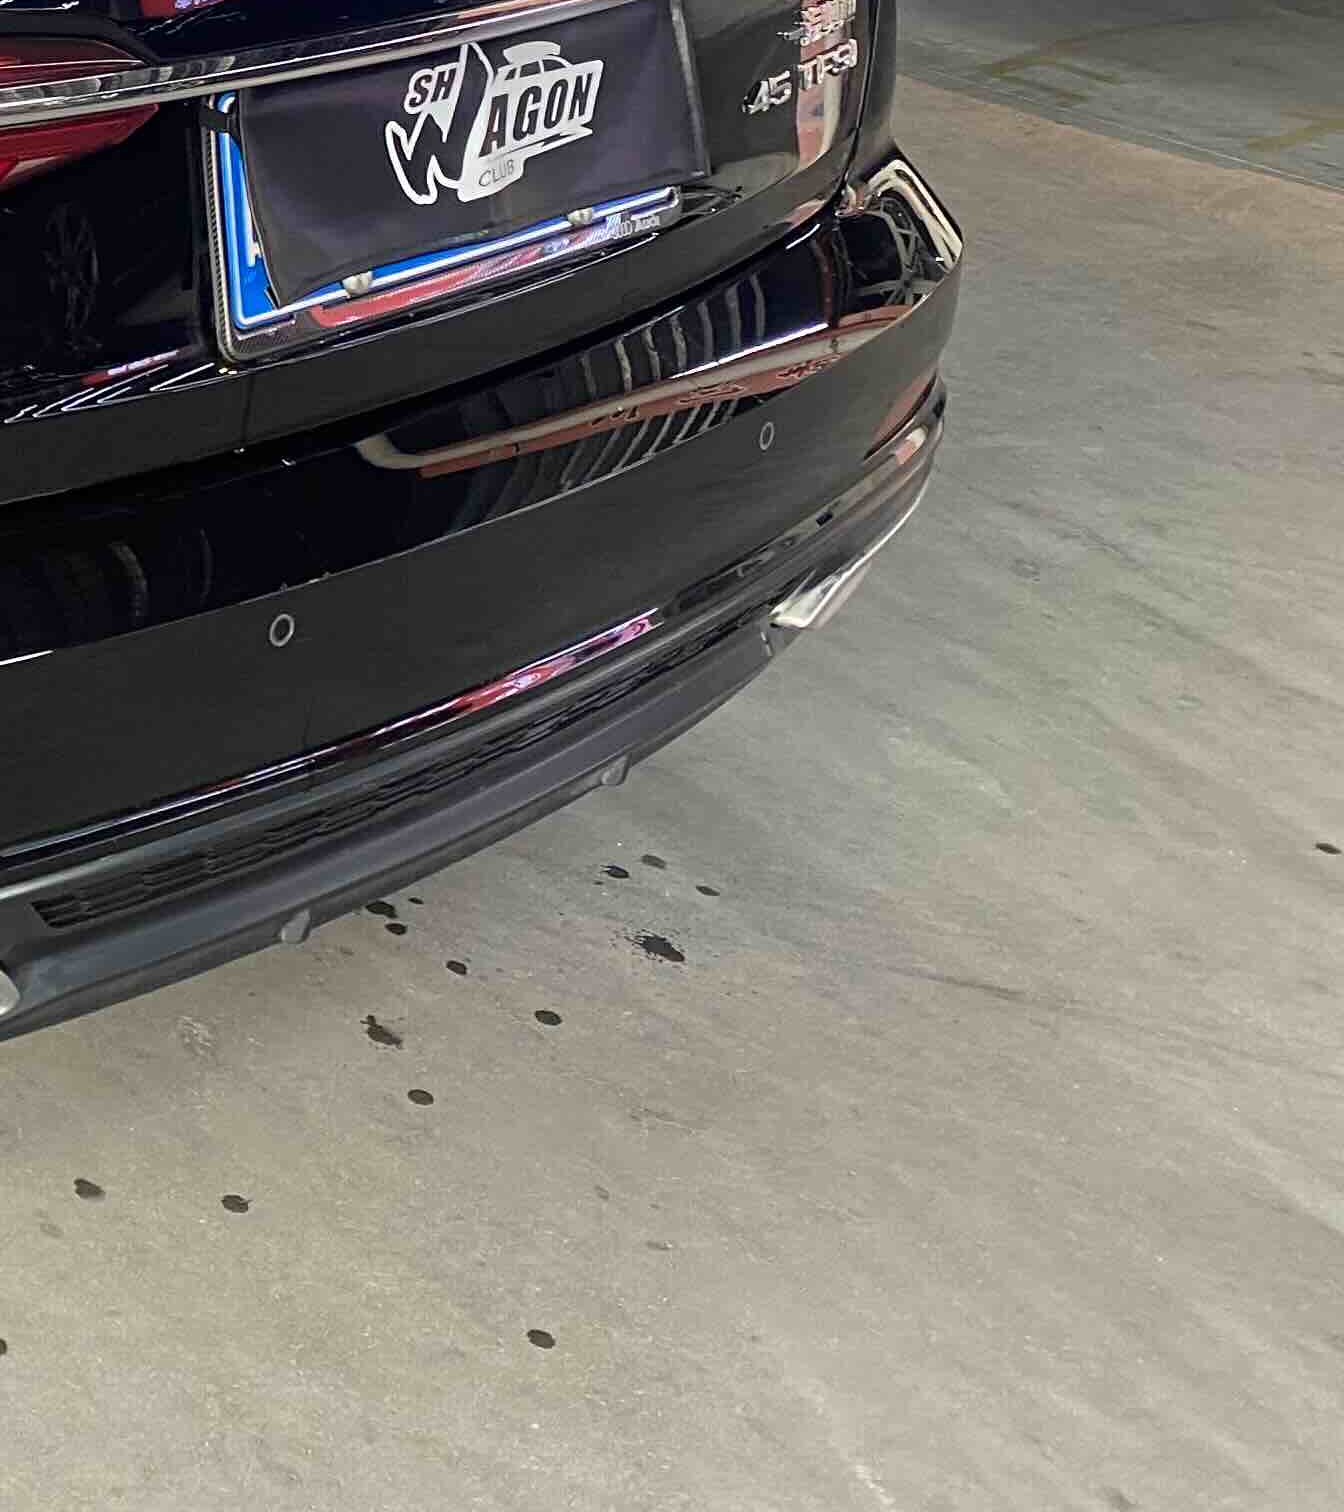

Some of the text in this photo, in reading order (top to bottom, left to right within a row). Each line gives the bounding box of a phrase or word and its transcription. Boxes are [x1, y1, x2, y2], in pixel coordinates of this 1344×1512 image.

[742, 38, 859, 115] 45 TFSI
[477, 158, 516, 188] CLUB
